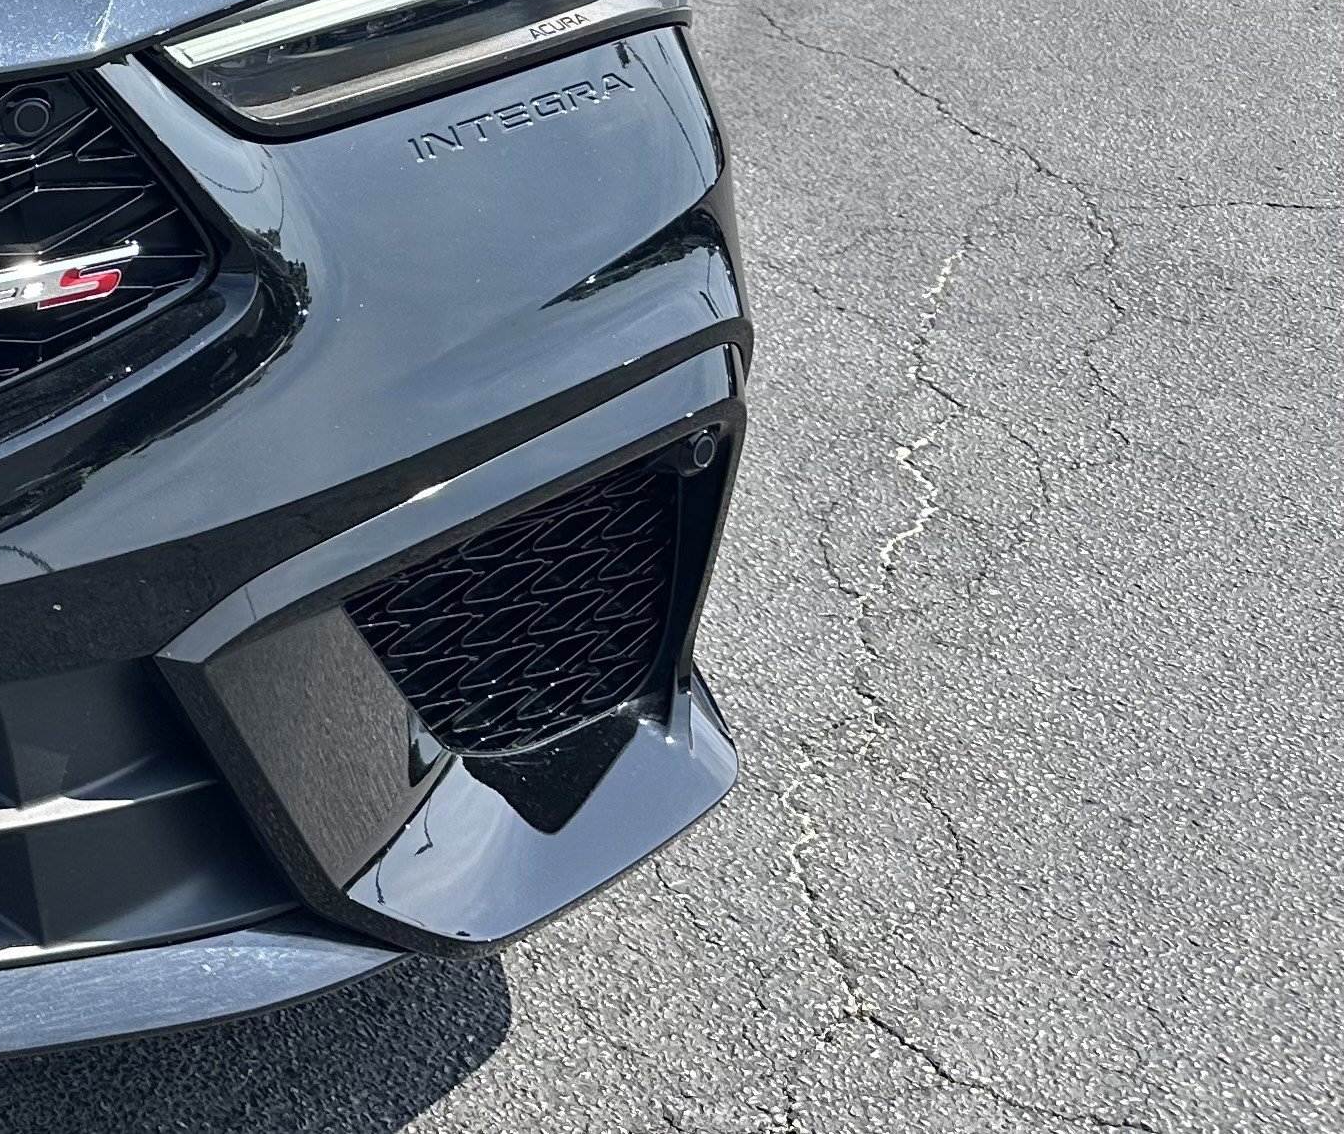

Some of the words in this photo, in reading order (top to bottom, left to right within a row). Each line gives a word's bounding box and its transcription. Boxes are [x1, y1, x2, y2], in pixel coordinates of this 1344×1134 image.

[529, 13, 591, 40] ACURA
[408, 72, 636, 163] INTEGRA
[37, 266, 122, 310] S
